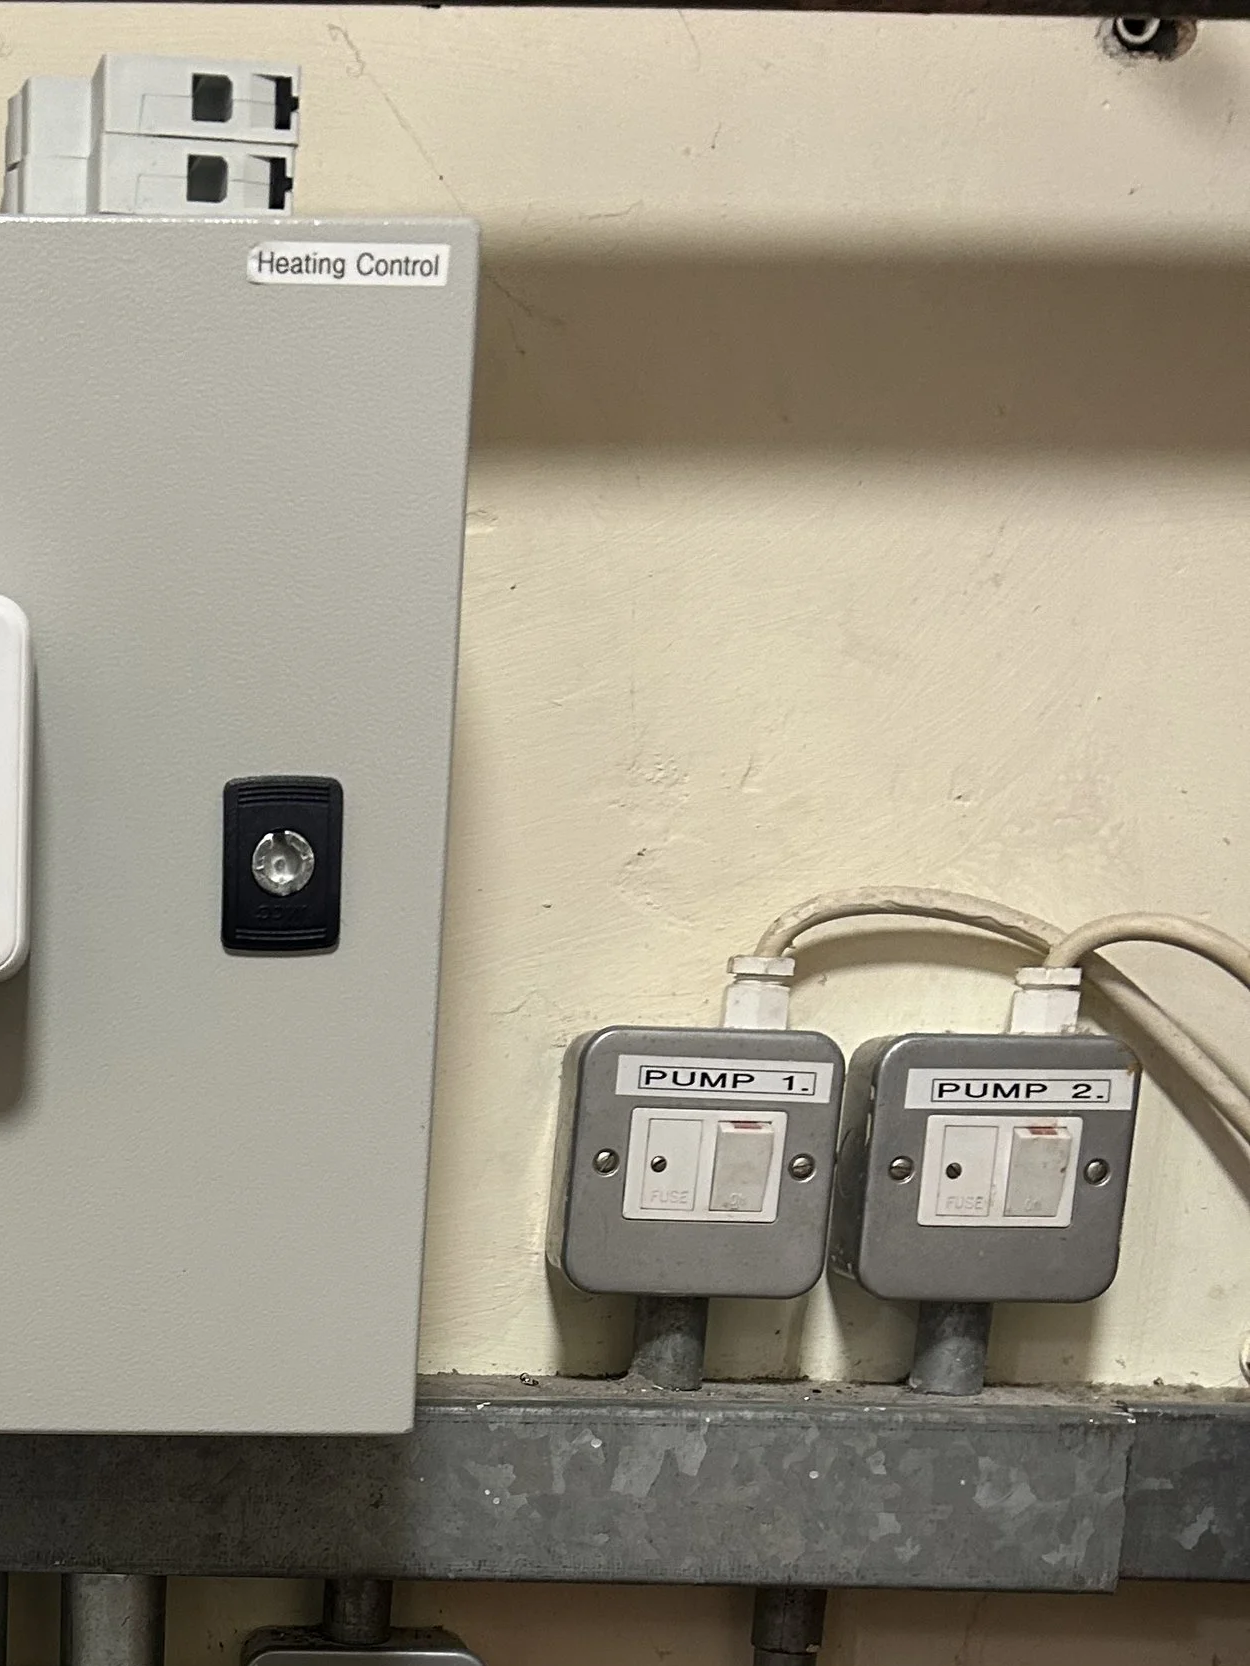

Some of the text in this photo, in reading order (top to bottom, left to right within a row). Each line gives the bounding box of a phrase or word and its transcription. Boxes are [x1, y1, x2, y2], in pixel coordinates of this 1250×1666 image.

[257, 251, 440, 280] Heating Control
[643, 1070, 811, 1093] PUMP 1.
[936, 1081, 1104, 1100] PUMP 2.
